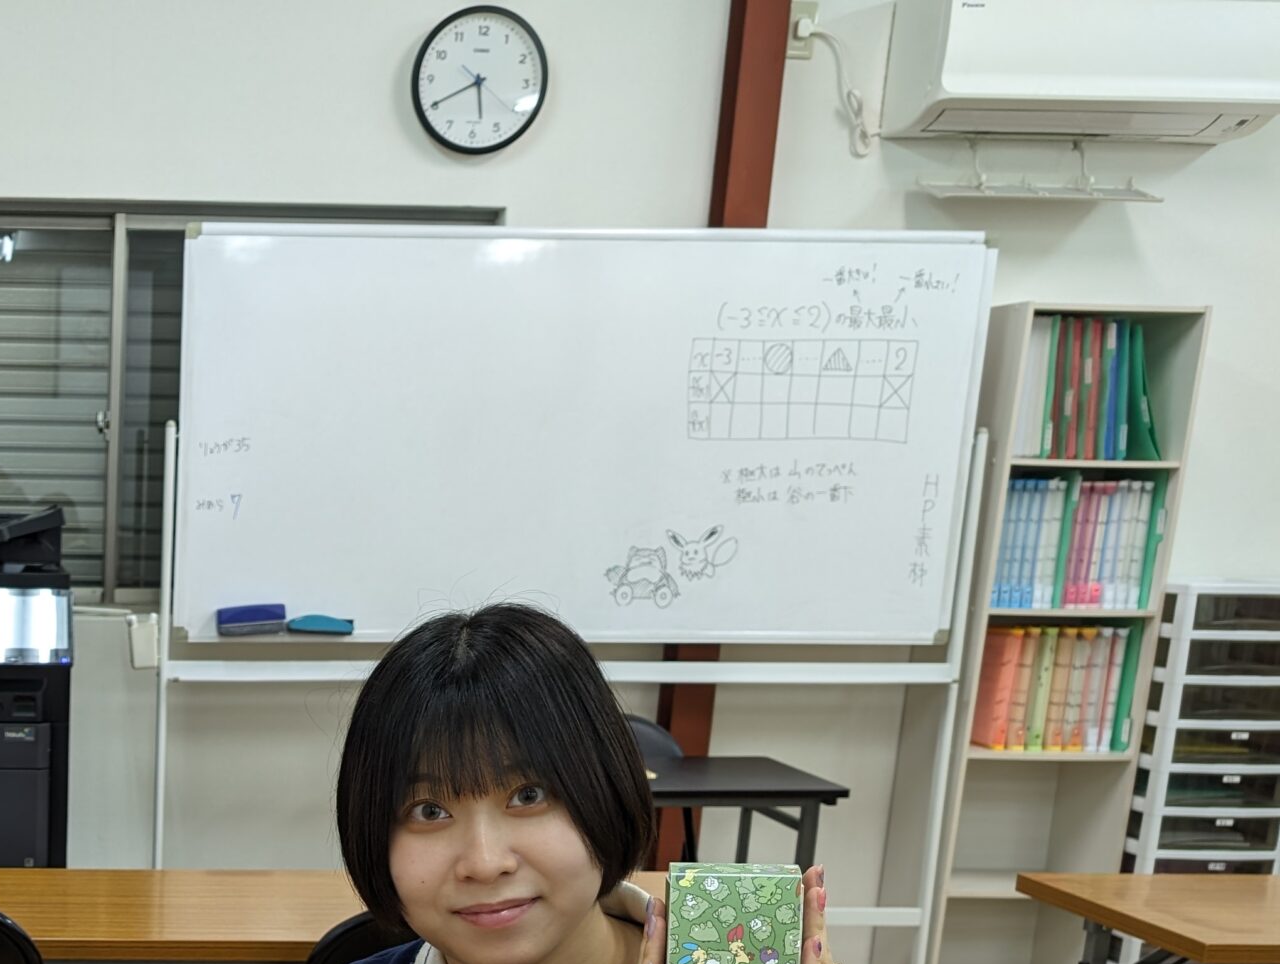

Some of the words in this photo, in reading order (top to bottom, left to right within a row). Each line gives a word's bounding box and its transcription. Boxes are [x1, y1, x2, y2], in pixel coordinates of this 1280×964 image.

[478, 25, 490, 36] 12
[454, 32, 464, 42] 11
[504, 34, 510, 44] 1
[436, 50, 447, 60] 10
[519, 54, 527, 64] 2
[427, 74, 434, 84] 9
[522, 79, 529, 89] 3
[446, 120, 453, 130] 7
[492, 122, 500, 132] 5
[468, 130, 476, 139] 6
[716, 347, 732, 365] -3
[895, 347, 907, 371] 2
